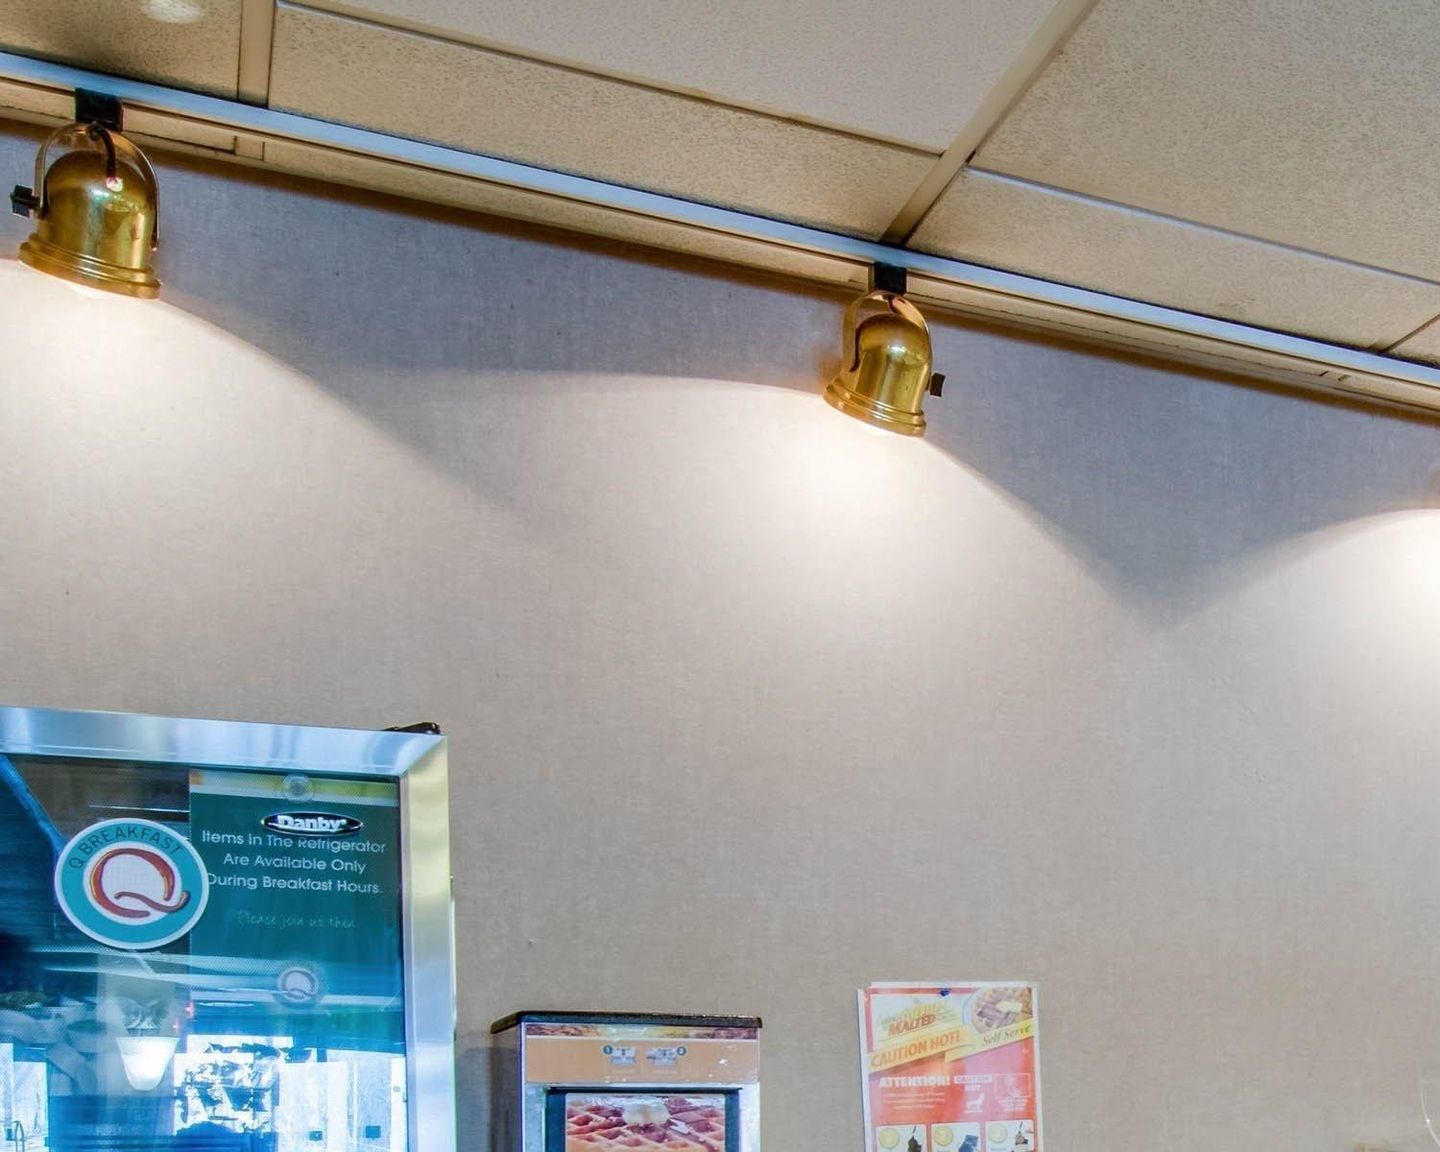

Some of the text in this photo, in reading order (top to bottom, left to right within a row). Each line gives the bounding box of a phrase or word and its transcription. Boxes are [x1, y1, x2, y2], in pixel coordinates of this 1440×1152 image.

[276, 815, 342, 833] Danby
[68, 825, 185, 869] Q BREAKFAST
[202, 830, 244, 845] Items
[267, 834, 294, 848] The
[298, 837, 387, 854] Refrigerator
[223, 853, 367, 874] Are Available Only
[89, 848, 191, 918] Q
[207, 872, 258, 889] During
[262, 876, 333, 891] Breakfast
[982, 1024, 1032, 1047] Self Serve
[870, 1030, 962, 1068] CAUTION HOT!
[879, 1075, 950, 1088] ATTENTION!
